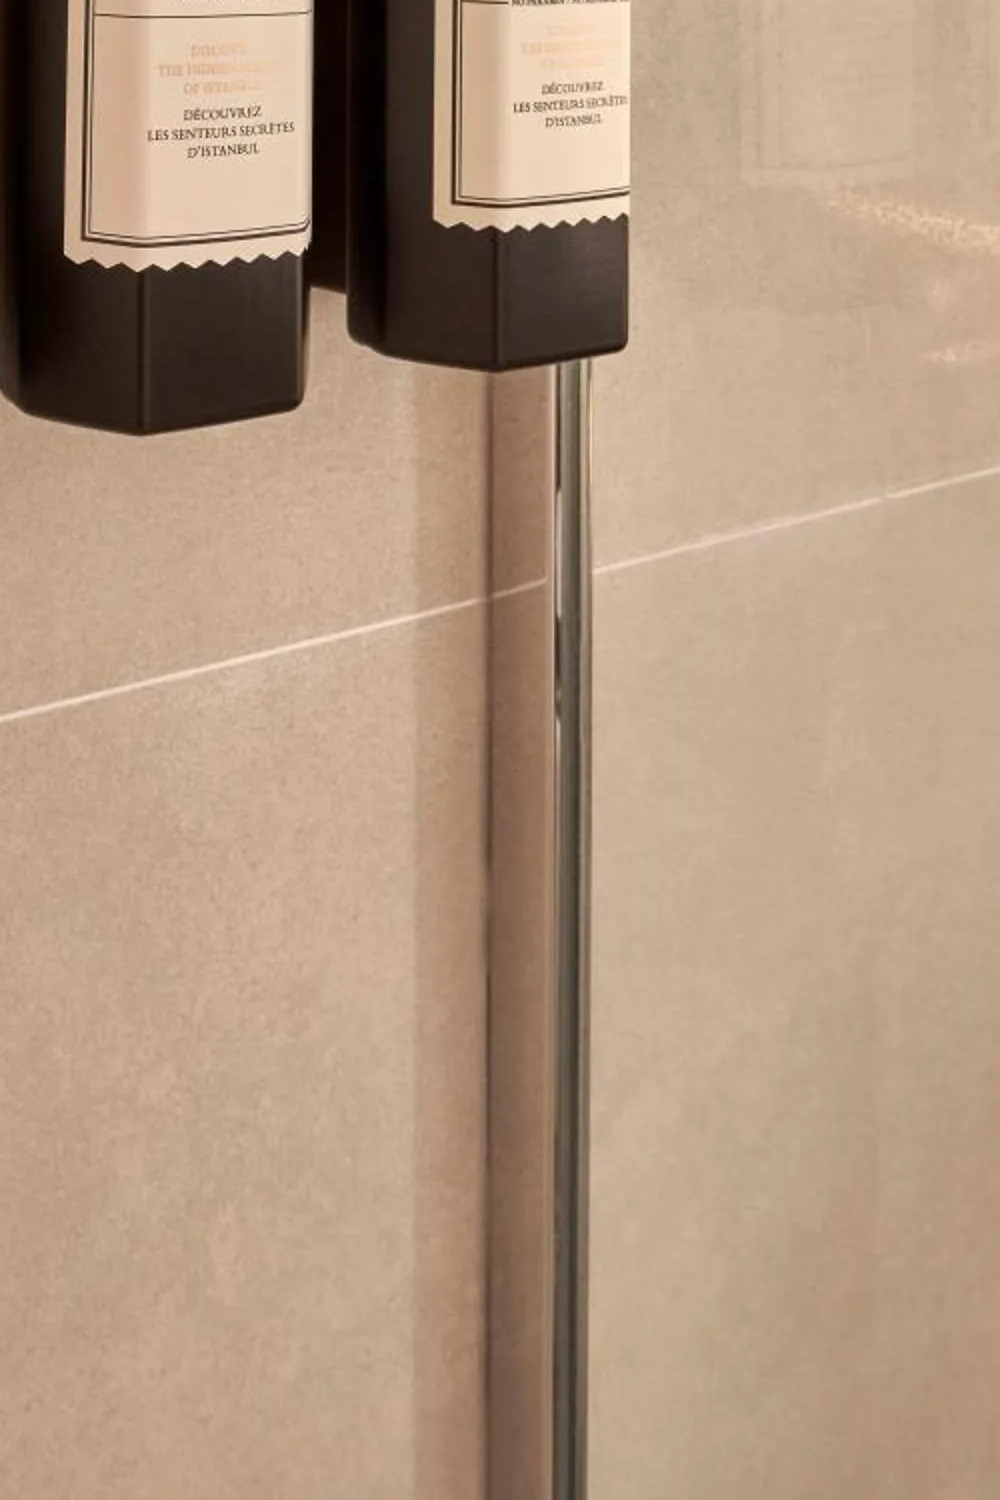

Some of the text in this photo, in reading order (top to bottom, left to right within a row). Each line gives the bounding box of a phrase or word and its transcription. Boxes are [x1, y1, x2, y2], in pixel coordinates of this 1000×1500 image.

[183, 104, 263, 122] DÉCOUVREZ
[513, 102, 531, 114] LES
[532, 98, 584, 113] SENTEURS
[147, 129, 169, 142] LES
[171, 125, 237, 141] SENTEURS
[187, 143, 261, 159] D'ISTANBUL
